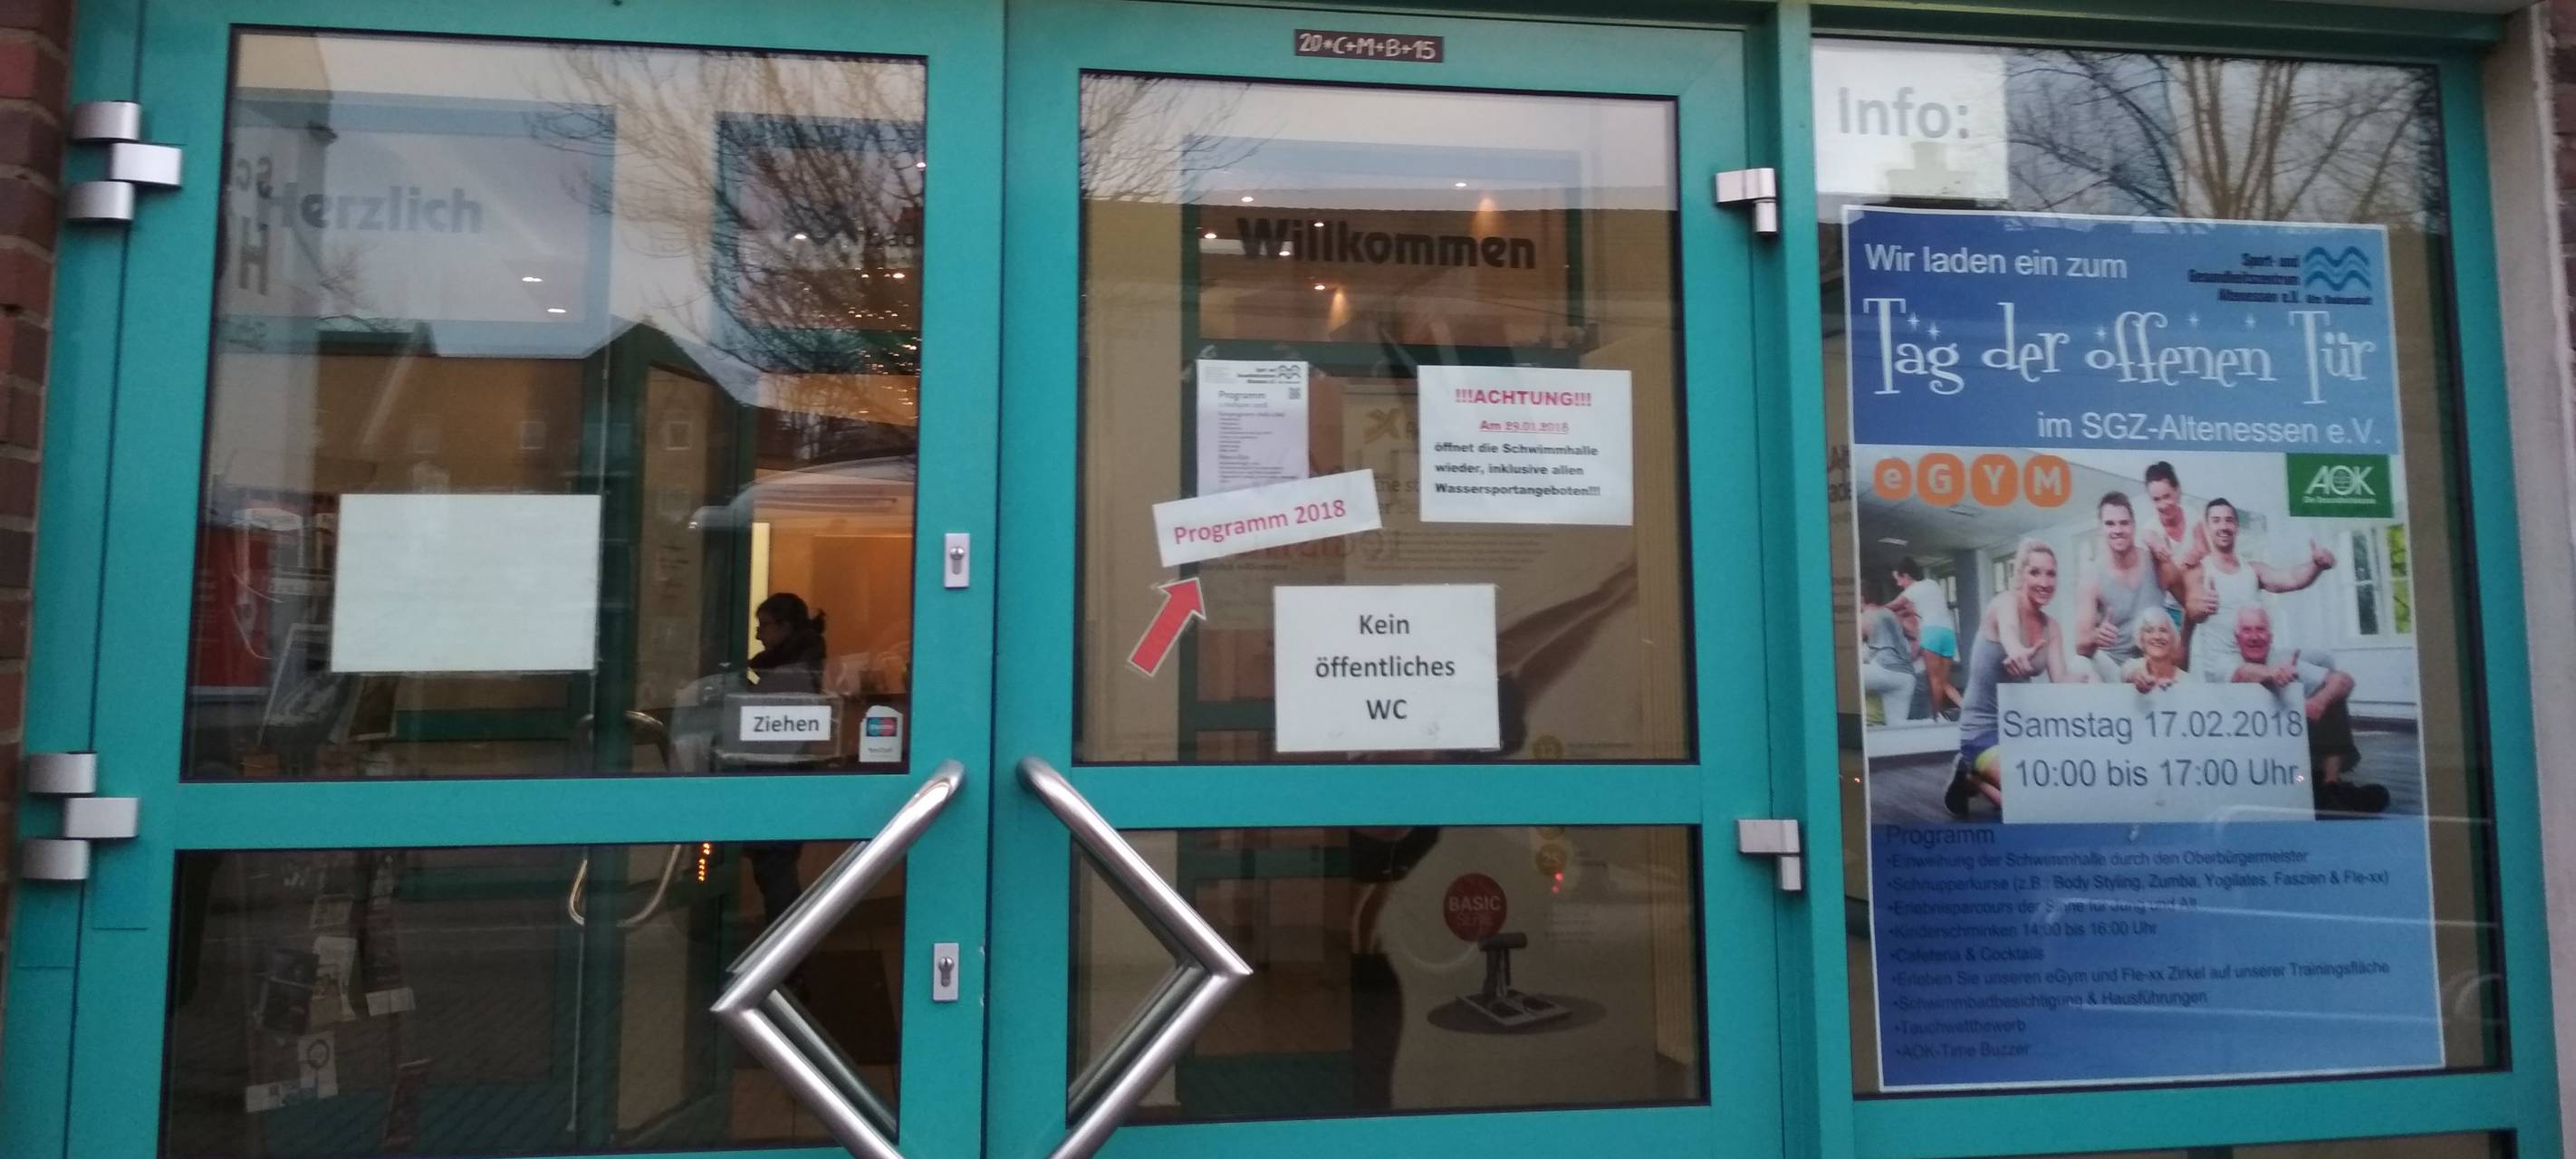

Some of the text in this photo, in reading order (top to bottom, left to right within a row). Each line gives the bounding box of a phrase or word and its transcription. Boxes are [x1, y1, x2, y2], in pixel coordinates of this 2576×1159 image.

[1838, 87, 1969, 139] Info:
[257, 181, 483, 233] Herzlich
[1236, 217, 1536, 270] Willkommen
[1864, 243, 2128, 278] Wir laden ein zum
[1862, 298, 2377, 404] Tag der offenen Tür
[1456, 388, 1591, 406] !!!ACHTUNG!!!
[1480, 420, 1501, 430] Am
[2037, 411, 2382, 445] im SGZ-Altenessen e.V.
[1434, 442, 1599, 455] öffnet die Schwimmhalle
[1435, 463, 1584, 475] wieder, inklusive allen
[2305, 465, 2376, 495] AOK
[1435, 483, 1600, 497] Wassersportangeboten!!!
[1174, 514, 1288, 544] Programm
[1295, 499, 1346, 525] 2018
[1360, 613, 1410, 635] Kein
[1315, 655, 1456, 677] öffentliches
[1366, 699, 1408, 720] WC
[754, 715, 820, 733] Ziehen
[2003, 710, 2303, 744] Samstag 17.02.2018
[2015, 758, 2299, 787] 10:00 bis 17:00 Uhr
[1887, 825, 1995, 848] Programm
[1979, 855, 2000, 867] der
[2006, 852, 2106, 867] Schwimmhalle
[2111, 851, 2149, 866] durch
[2155, 852, 2179, 865] den
[2184, 849, 2308, 867] Oberbürgermeister
[1893, 876, 2009, 892] Schnupperkurse
[2053, 875, 2089, 891] Body
[2274, 870, 2326, 886] Faszien
[2330, 871, 2340, 884] &
[1449, 895, 1501, 912] BASIC
[2065, 923, 2085, 935] bis
[2133, 921, 2157, 934] Uhr
[1966, 948, 1975, 961] &
[1981, 946, 2044, 961] Cocktails
[1897, 961, 2389, 985] Erleben Sie unseren eGym und Fle-xx Zirkel auf unserer Trainingsfläche
[2087, 992, 2097, 1005] &
[2102, 991, 2207, 1007] Hausführungen
[1902, 1020, 2026, 1035] Tauchwettbewerb
[1981, 1042, 2030, 1058] Buzzer
